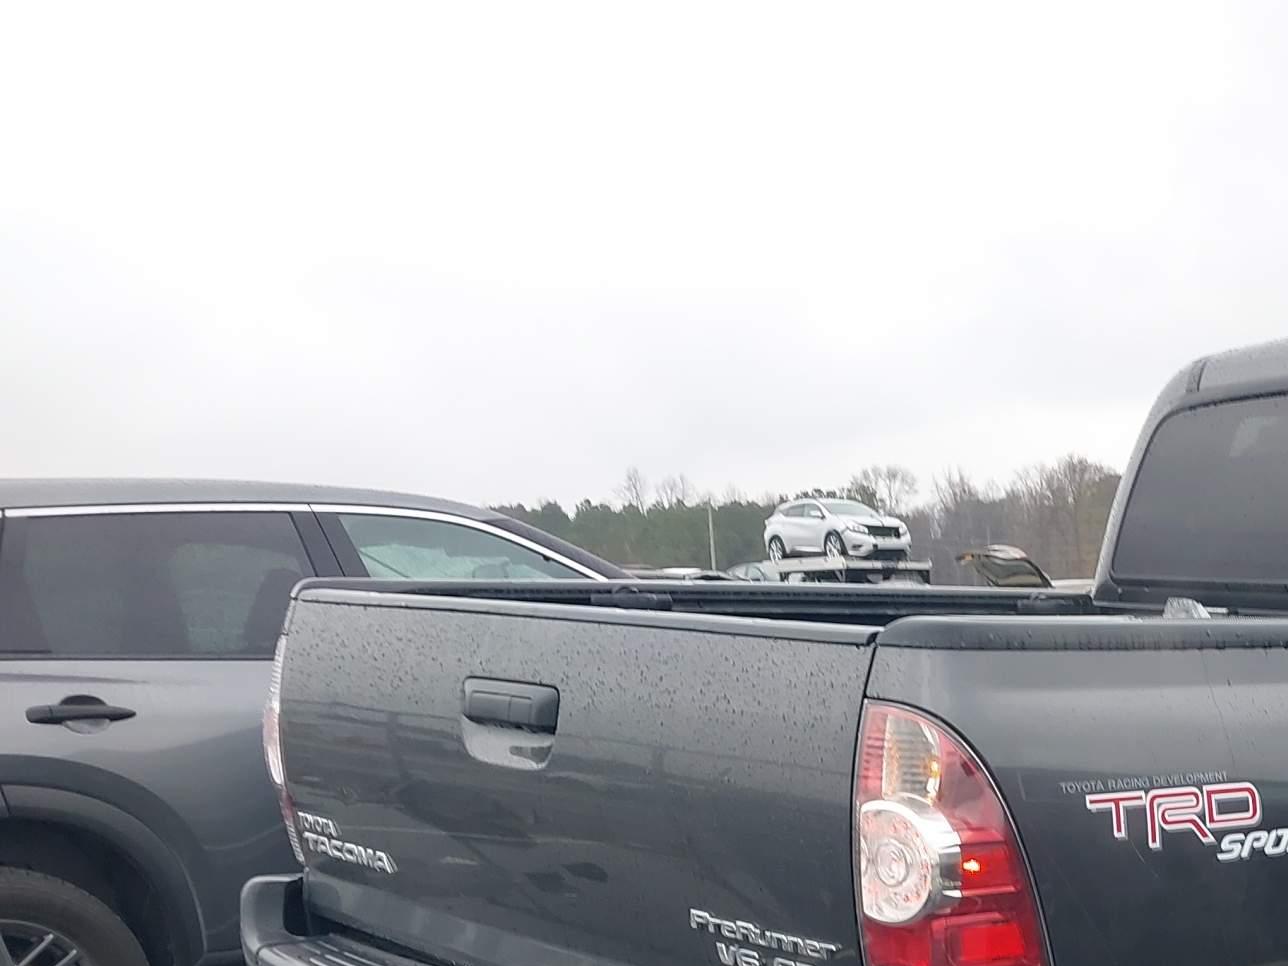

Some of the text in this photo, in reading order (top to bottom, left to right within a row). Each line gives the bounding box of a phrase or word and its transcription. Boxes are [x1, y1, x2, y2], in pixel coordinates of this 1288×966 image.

[1059, 770, 1228, 794] TOYOTA RACING DEVELOPMENT
[1086, 781, 1262, 850] TRD
[303, 831, 397, 874] TACOMA
[689, 908, 837, 960] PreRunner
